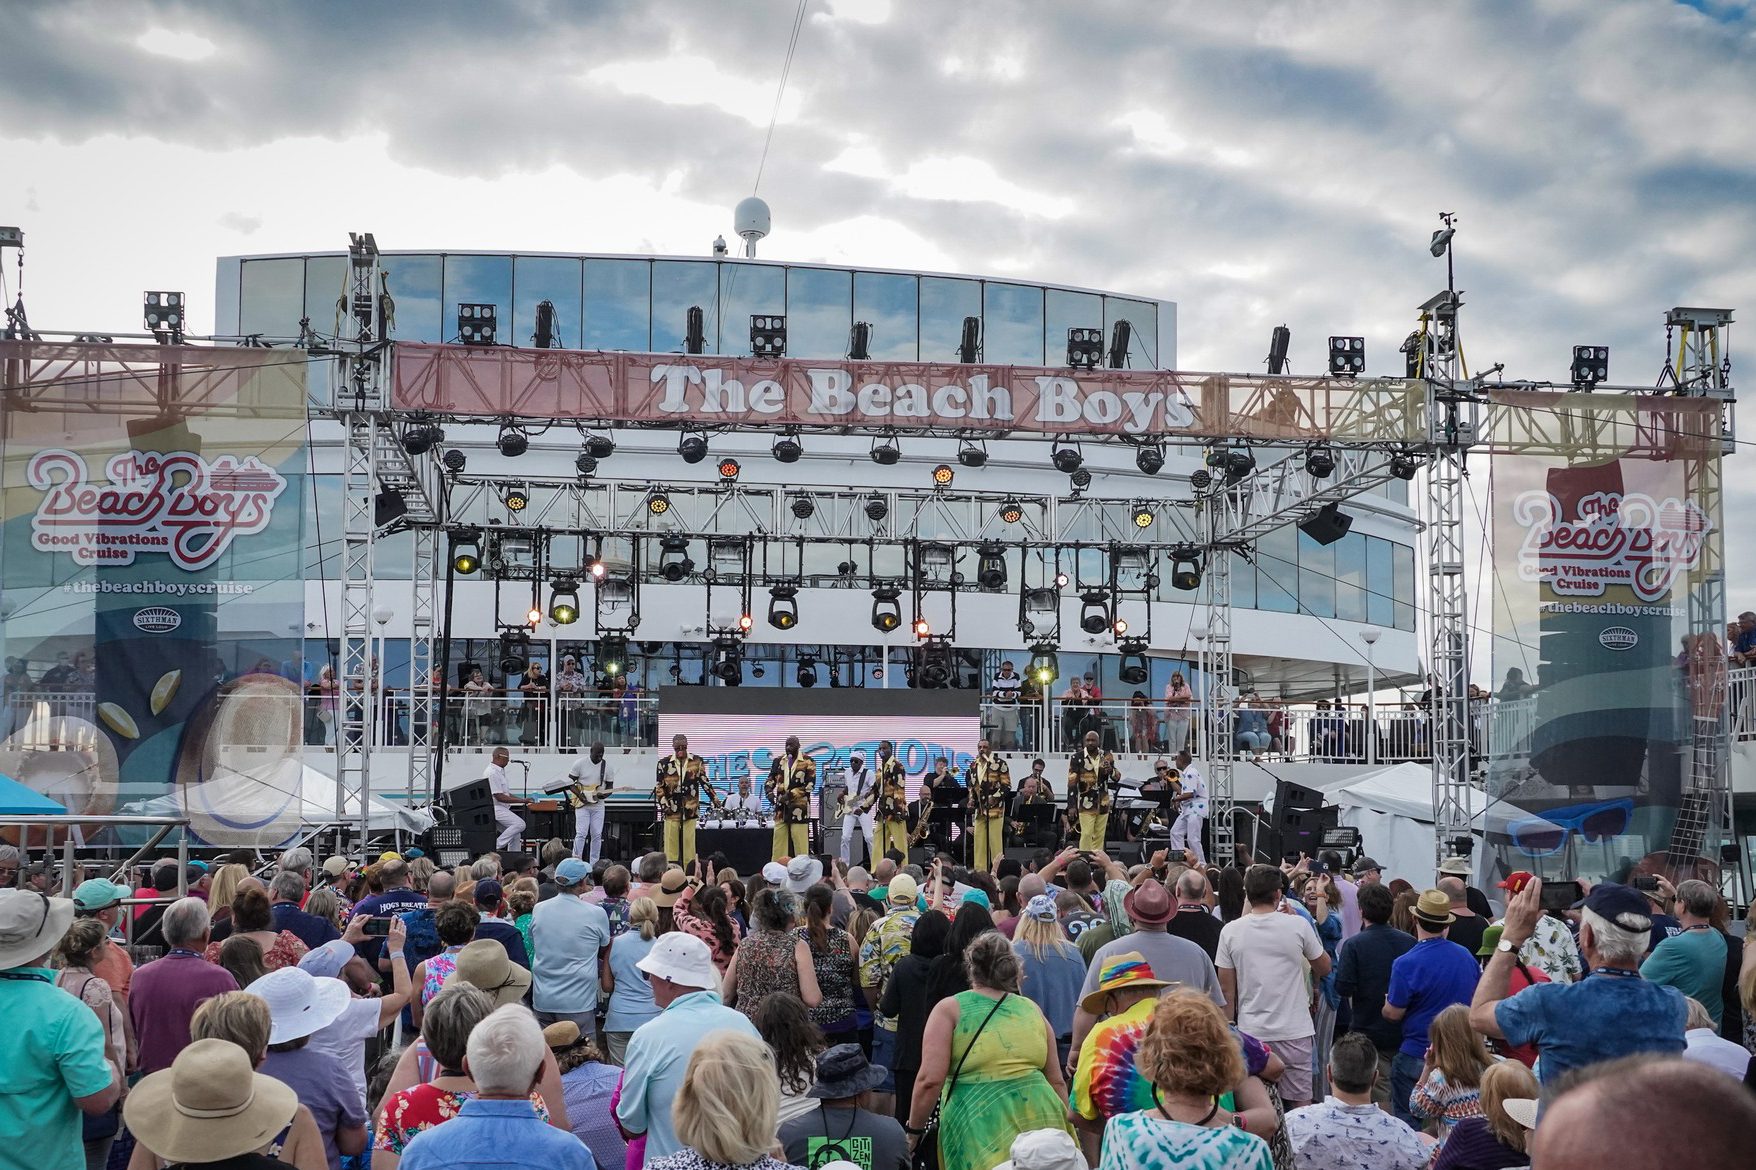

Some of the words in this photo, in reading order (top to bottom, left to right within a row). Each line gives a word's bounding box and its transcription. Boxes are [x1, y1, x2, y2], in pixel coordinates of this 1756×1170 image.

[650, 364, 784, 415] The
[807, 368, 1015, 421] Beach
[1034, 376, 1196, 433] Boys
[112, 455, 160, 487] The
[33, 454, 166, 525] Beach
[160, 457, 268, 564] Boys
[1583, 496, 1620, 518] The
[38, 533, 80, 545] Good
[85, 532, 169, 546] Vibrations
[1517, 493, 1627, 560] Beach
[1619, 496, 1699, 595] Boys
[78, 547, 129, 559] Cruise
[1523, 564, 1558, 576] Good
[1561, 565, 1631, 578] Vibrations
[63, 580, 253, 597] #thebeachboyscruise
[1556, 578, 1600, 590] Cruise
[1540, 601, 1686, 617] #thebeachboyscruise
[137, 616, 178, 624] SIXTHMAN
[400, 902, 429, 910] BREATH
